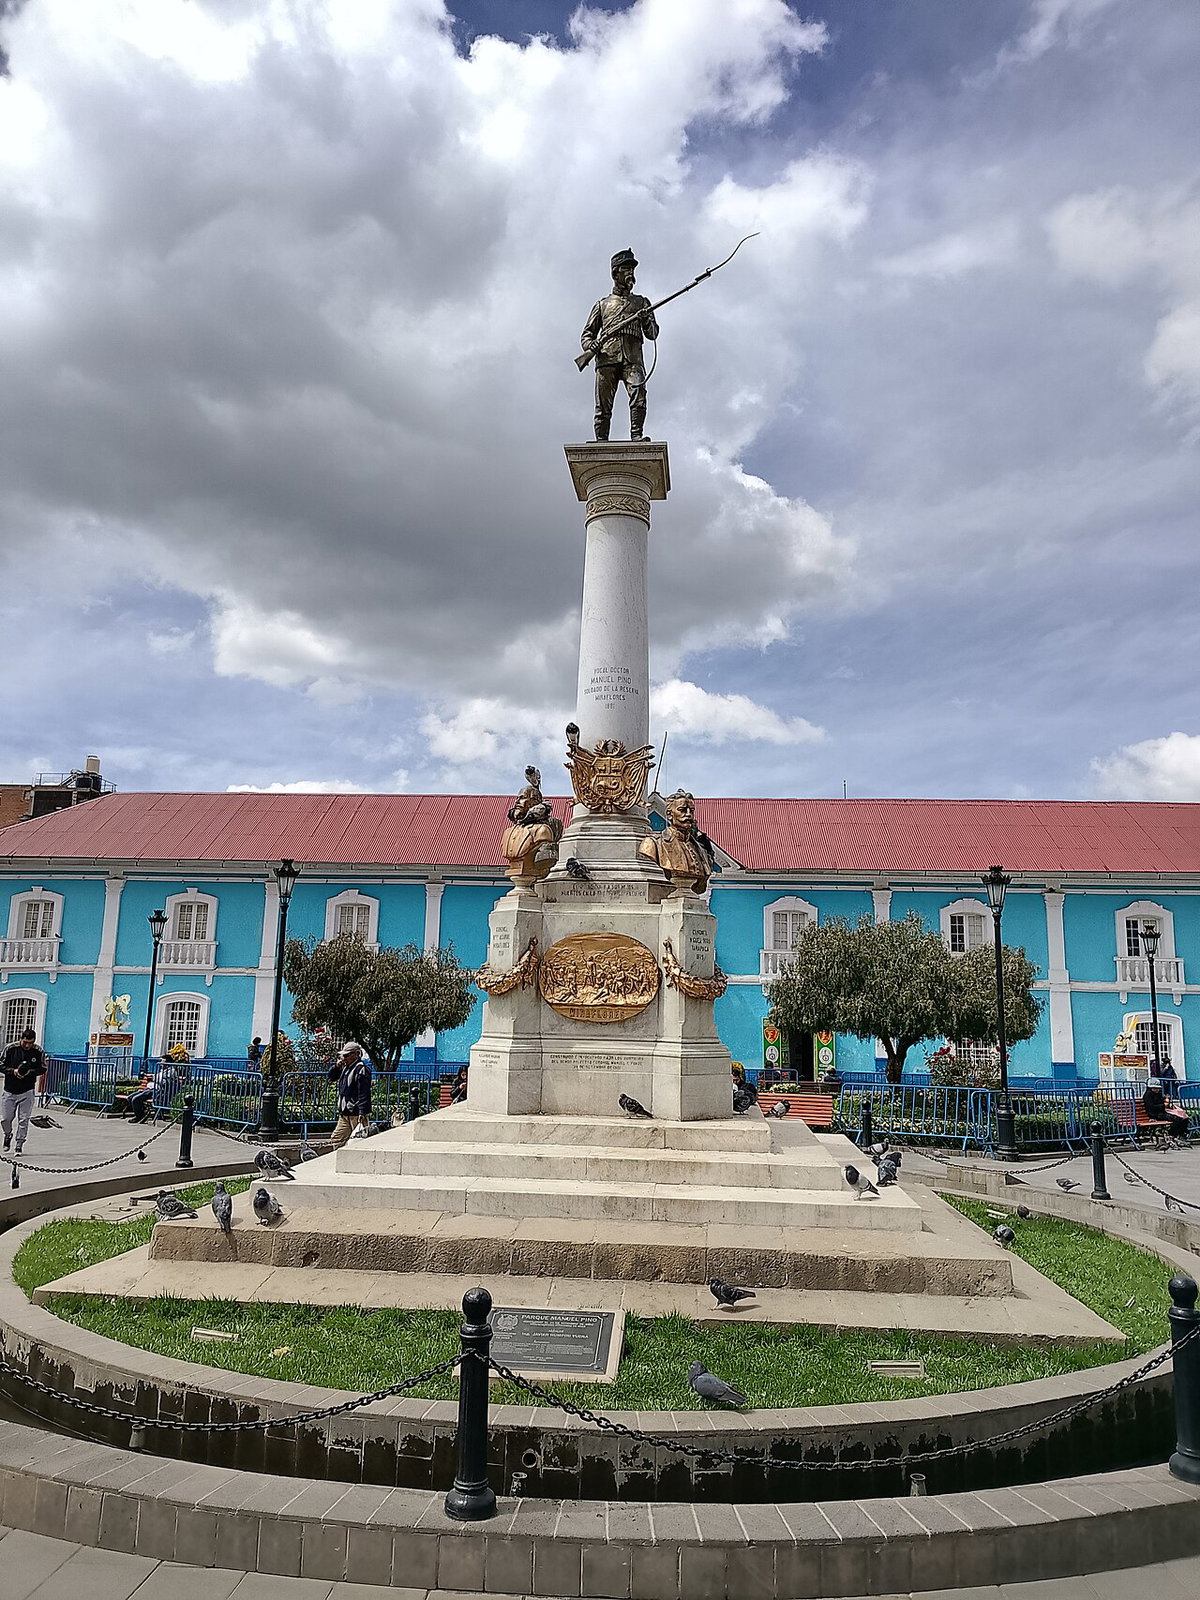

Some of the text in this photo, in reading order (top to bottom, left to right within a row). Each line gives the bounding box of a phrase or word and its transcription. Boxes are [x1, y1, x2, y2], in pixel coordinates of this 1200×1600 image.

[590, 676, 632, 684] MANUEL PINO
[568, 1007, 625, 1019] MIRAFLORES
[550, 1315, 579, 1323] MANUEL
